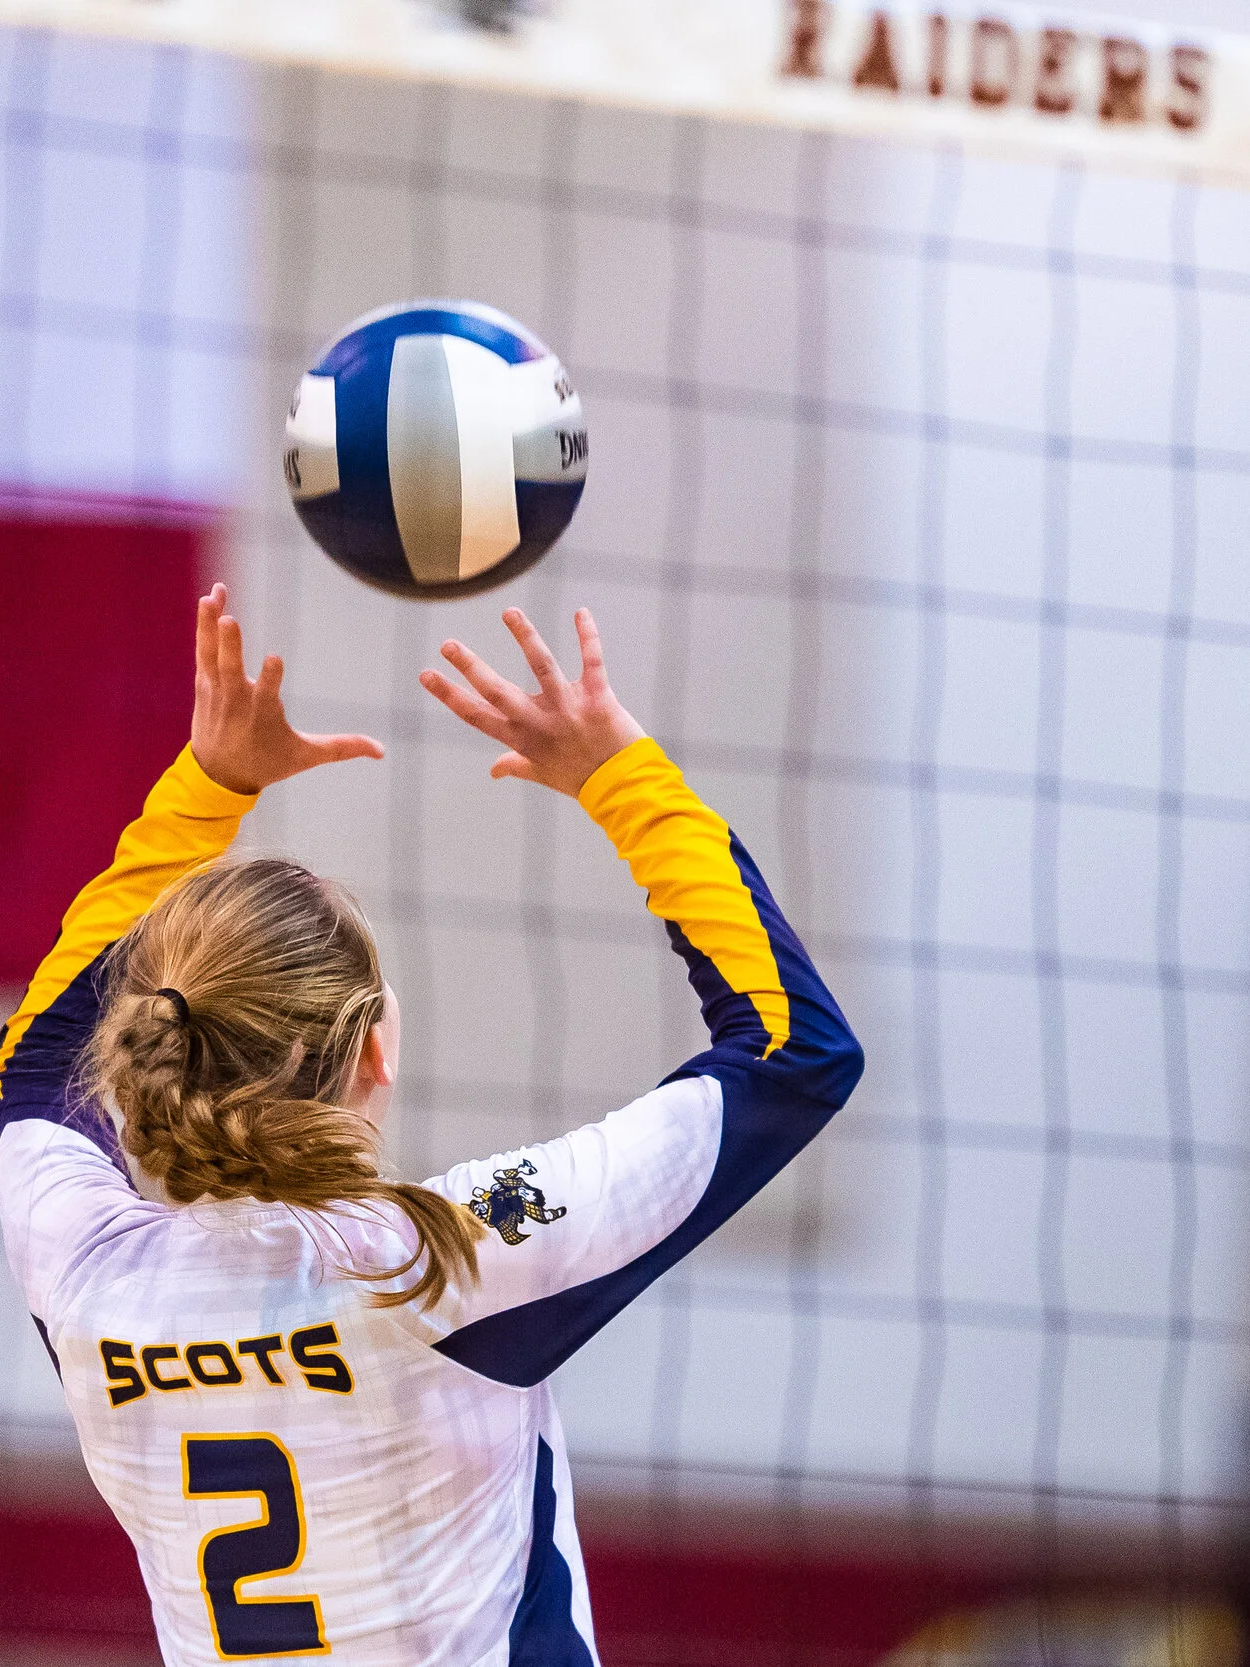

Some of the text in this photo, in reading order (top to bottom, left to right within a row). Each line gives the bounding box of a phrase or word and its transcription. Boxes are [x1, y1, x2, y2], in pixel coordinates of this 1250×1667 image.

[777, 0, 1212, 131] RAIDERS
[99, 1321, 355, 1409] SCOTS
[180, 1431, 332, 1660] 2
